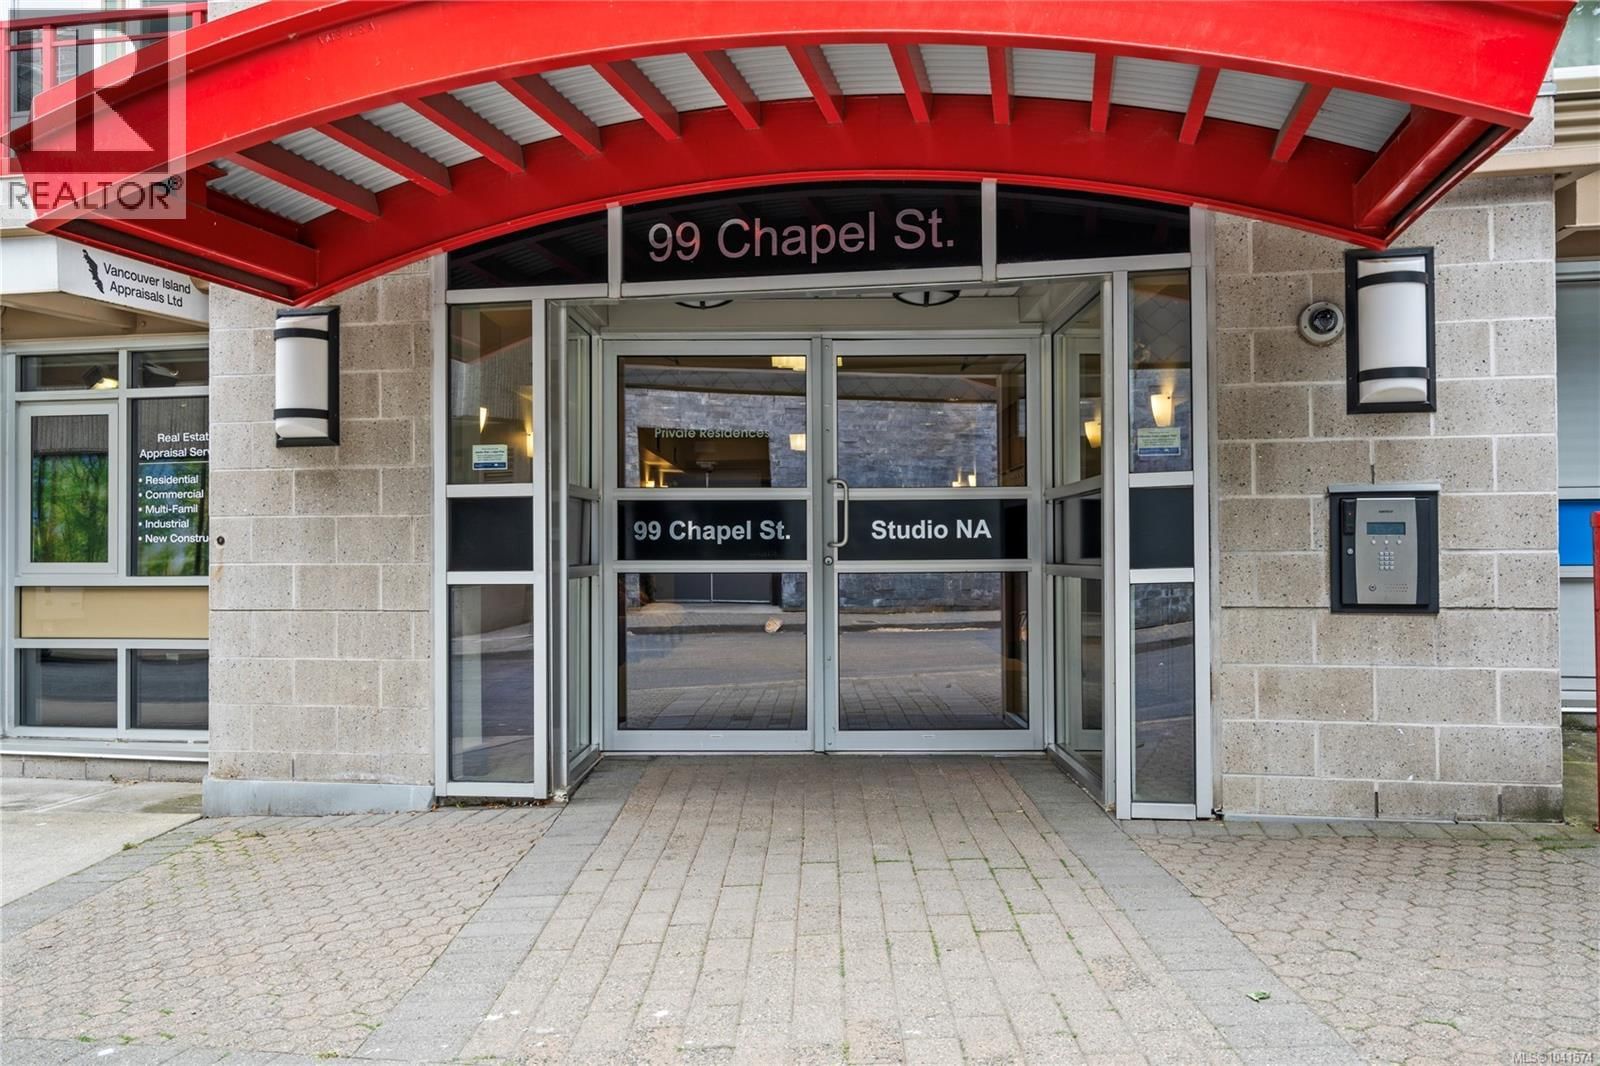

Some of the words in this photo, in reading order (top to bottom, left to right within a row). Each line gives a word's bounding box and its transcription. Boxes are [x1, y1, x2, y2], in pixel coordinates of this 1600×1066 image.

[648, 222, 701, 262] 99
[717, 211, 876, 264] Chapel
[894, 208, 954, 250] St.
[103, 262, 160, 287] Vancouver
[162, 278, 191, 294] Island
[110, 281, 165, 304] Appraisals
[167, 294, 183, 307] Ltd
[157, 432, 180, 443] Real
[654, 427, 697, 438] Private
[699, 427, 769, 438] Residences
[139, 447, 187, 460] Appraisal
[145, 474, 199, 485] Residential
[145, 489, 204, 499] Commercial
[145, 519, 189, 529] Industrial
[871, 519, 949, 540] Studio
[956, 519, 992, 539] NA
[633, 520, 662, 541] 99
[669, 520, 752, 544] Chapel
[759, 519, 791, 540] St.
[145, 534, 167, 543] New
